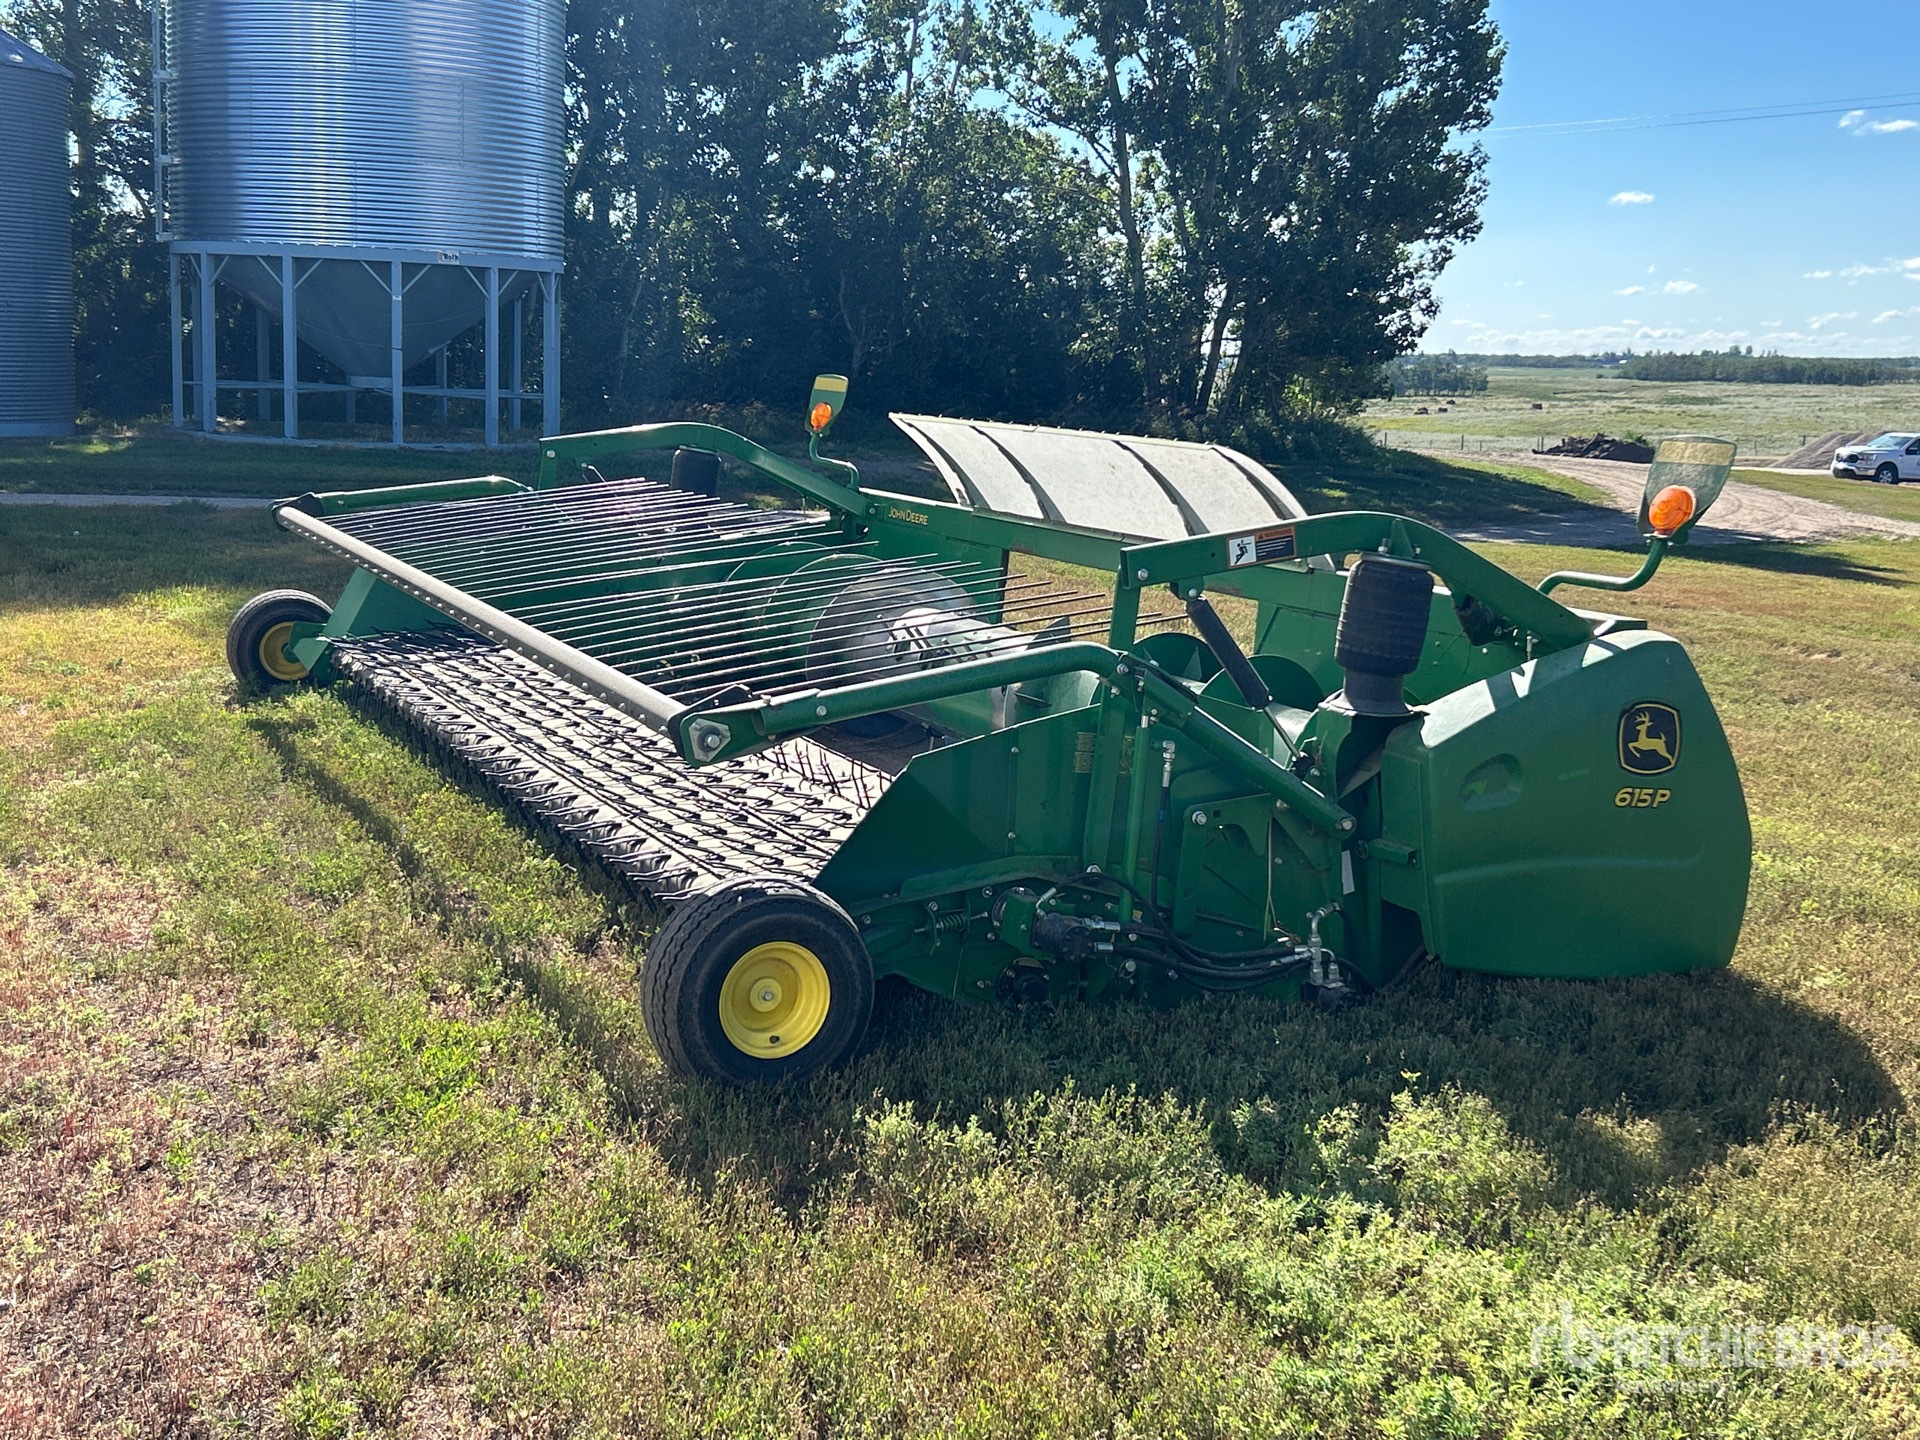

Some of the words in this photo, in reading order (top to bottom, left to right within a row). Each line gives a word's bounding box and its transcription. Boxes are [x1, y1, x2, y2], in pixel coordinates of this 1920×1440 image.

[888, 506, 906, 520] JOHN
[906, 509, 929, 526] DEERE
[1614, 787, 1671, 808] 615P
